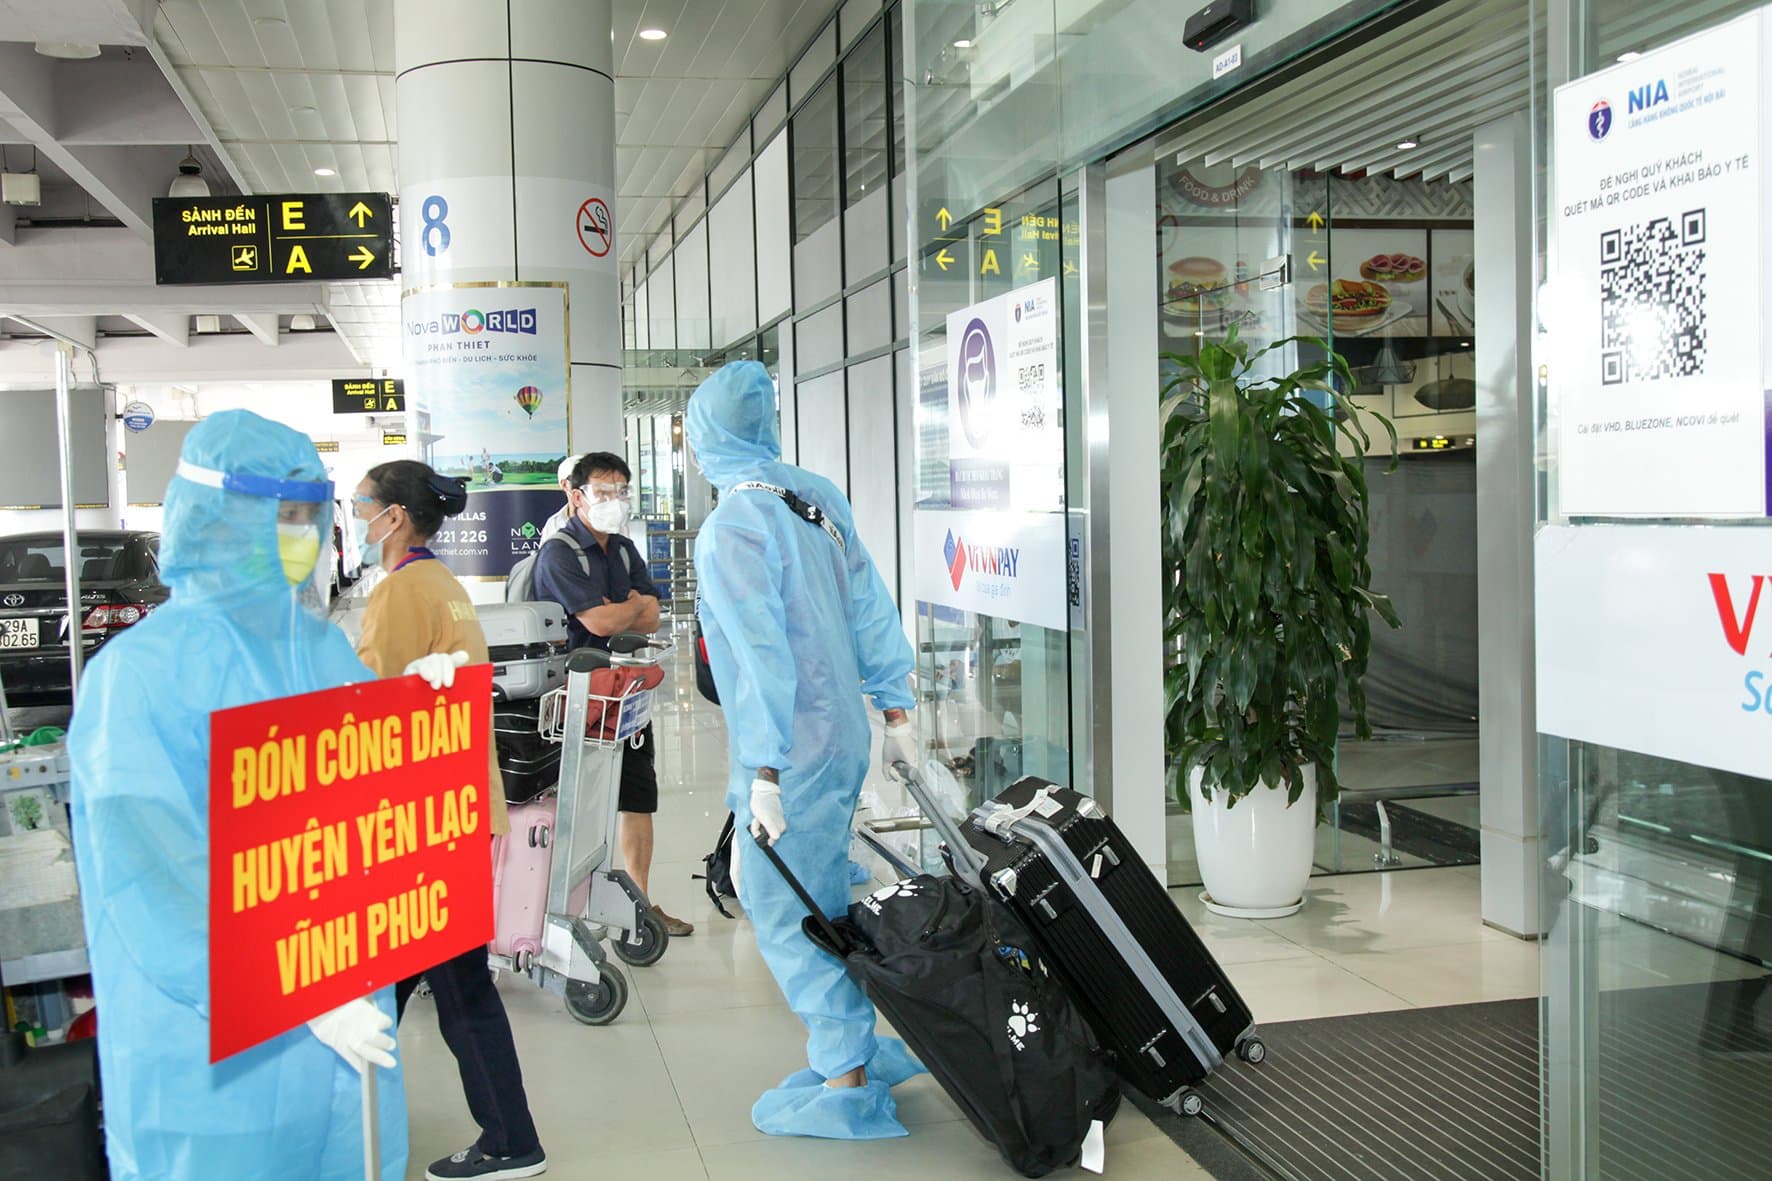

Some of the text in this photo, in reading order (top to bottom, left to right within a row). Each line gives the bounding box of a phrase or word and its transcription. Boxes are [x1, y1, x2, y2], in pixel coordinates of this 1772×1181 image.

[1628, 79, 1669, 114] NIA
[1615, 169, 1639, 186] NGHỊ
[1641, 160, 1662, 179] QUÝ
[1665, 150, 1703, 171] KHÁCH
[1178, 175, 1256, 203] FOOD & DRINK
[1606, 191, 1621, 206] QR
[1622, 183, 1650, 202] CODE
[1669, 171, 1695, 189] KHAI
[1697, 163, 1722, 181] BÁO
[1724, 160, 1733, 173] Y
[182, 204, 256, 223] SẢNH ĐẾN
[282, 201, 306, 231] E
[422, 195, 451, 257] 8
[188, 223, 256, 236] Arrival Hall
[285, 245, 313, 274] A
[384, 381, 395, 393] E
[386, 397, 398, 411] A
[1624, 416, 1674, 431] BLUEZONE,
[1676, 414, 1705, 427] NCOVI
[460, 530, 488, 543] 226
[511, 541, 541, 551] LAN
[6, 620, 28, 633] 29A
[1707, 573, 1772, 658] V
[232, 695, 472, 809] ĐÓN CÔNG DÂN
[233, 784, 479, 914] HUYỆN YÊN LẠC
[275, 872, 449, 996] VĨNH PHÚC
